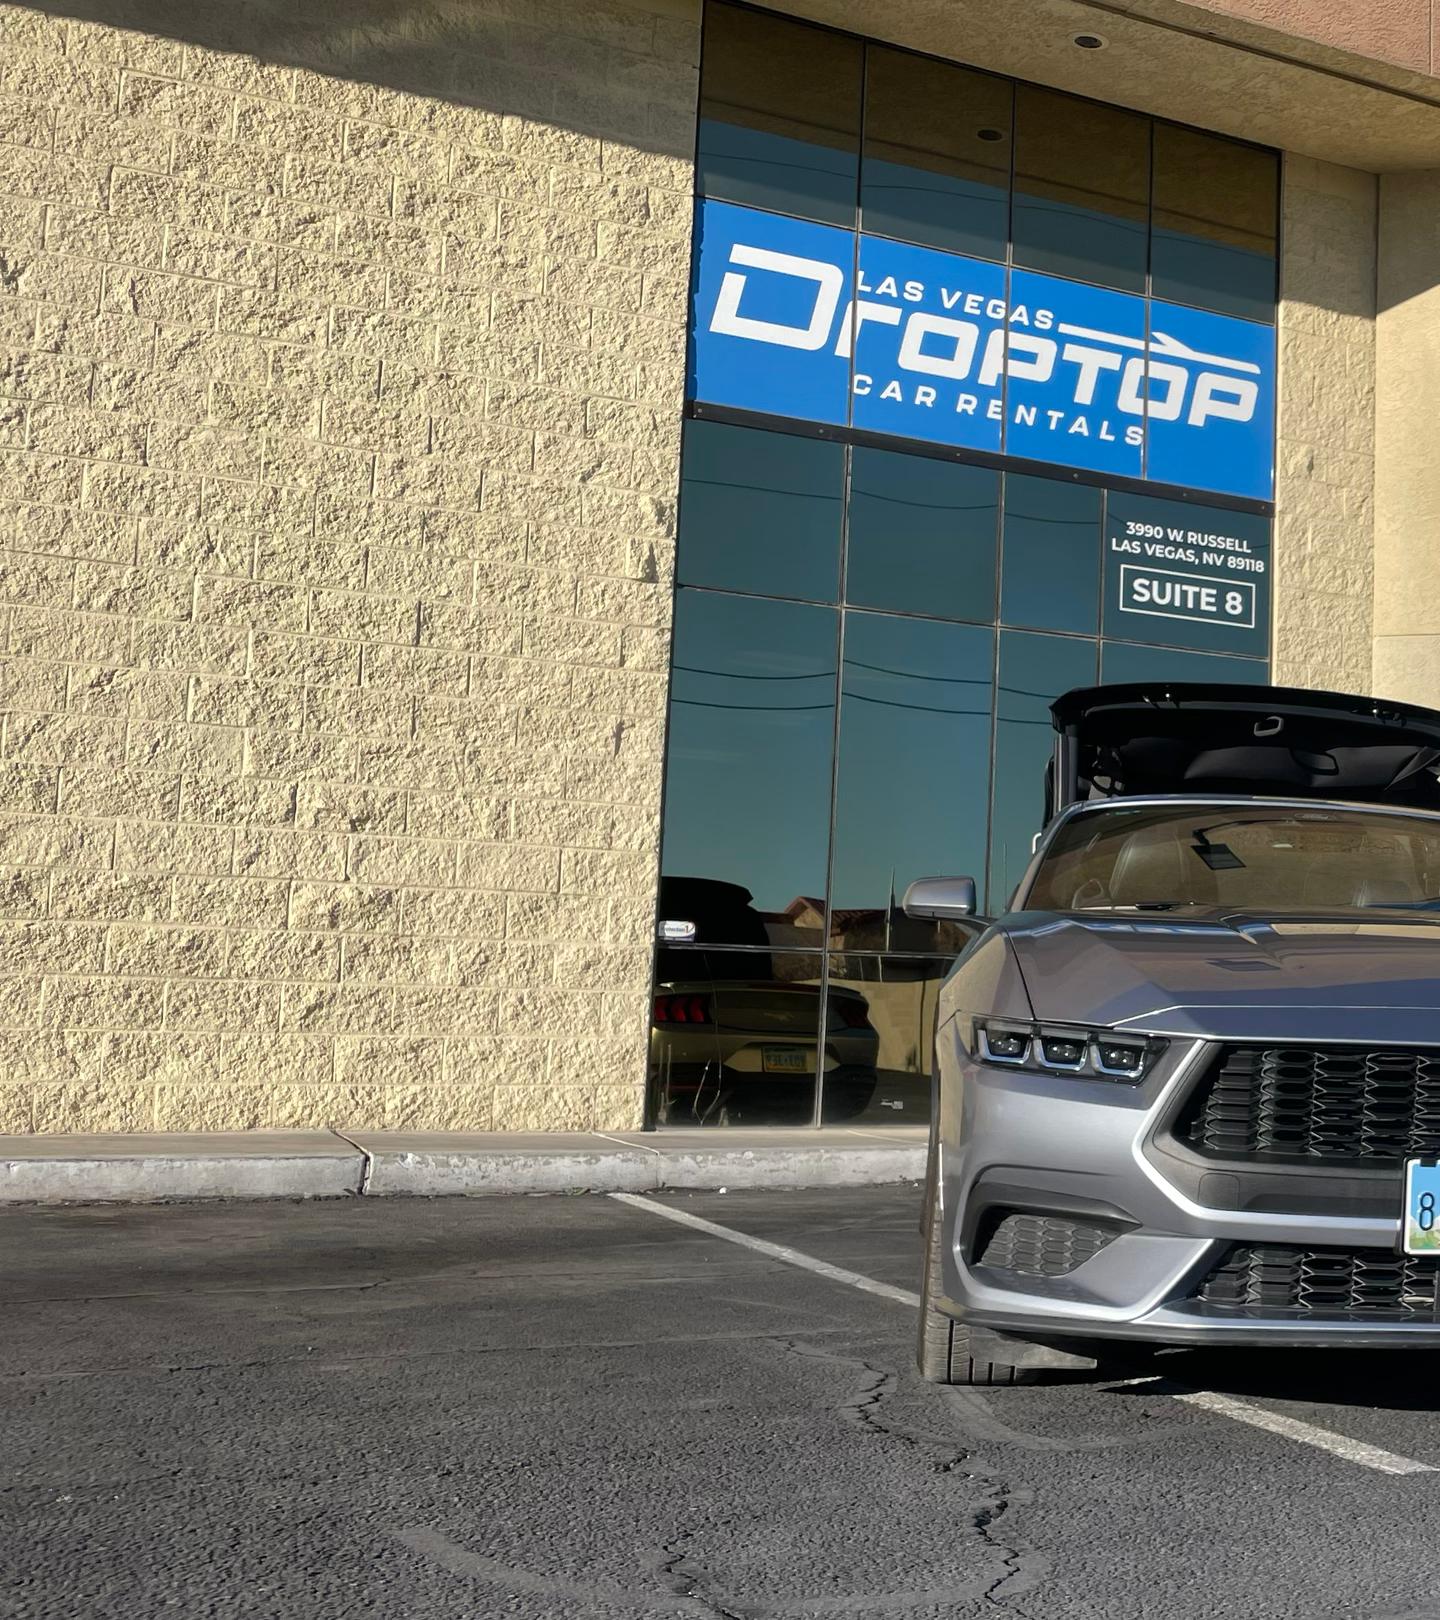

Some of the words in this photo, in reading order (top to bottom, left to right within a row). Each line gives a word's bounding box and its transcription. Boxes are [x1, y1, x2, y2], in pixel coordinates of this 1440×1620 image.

[857, 270, 924, 302] LAS
[940, 287, 1054, 330] VEGAS
[853, 373, 937, 408] CAR
[955, 393, 1144, 447] RENTALS
[1111, 537, 1141, 554] LAS
[1144, 543, 1199, 565] VEGAS,
[1202, 551, 1225, 567] NV
[1227, 555, 1264, 573] 89118
[1126, 521, 1163, 539] 3990
[1187, 531, 1251, 553] RUSSELL
[1132, 577, 1217, 612] SUITE
[1225, 591, 1243, 615] 8
